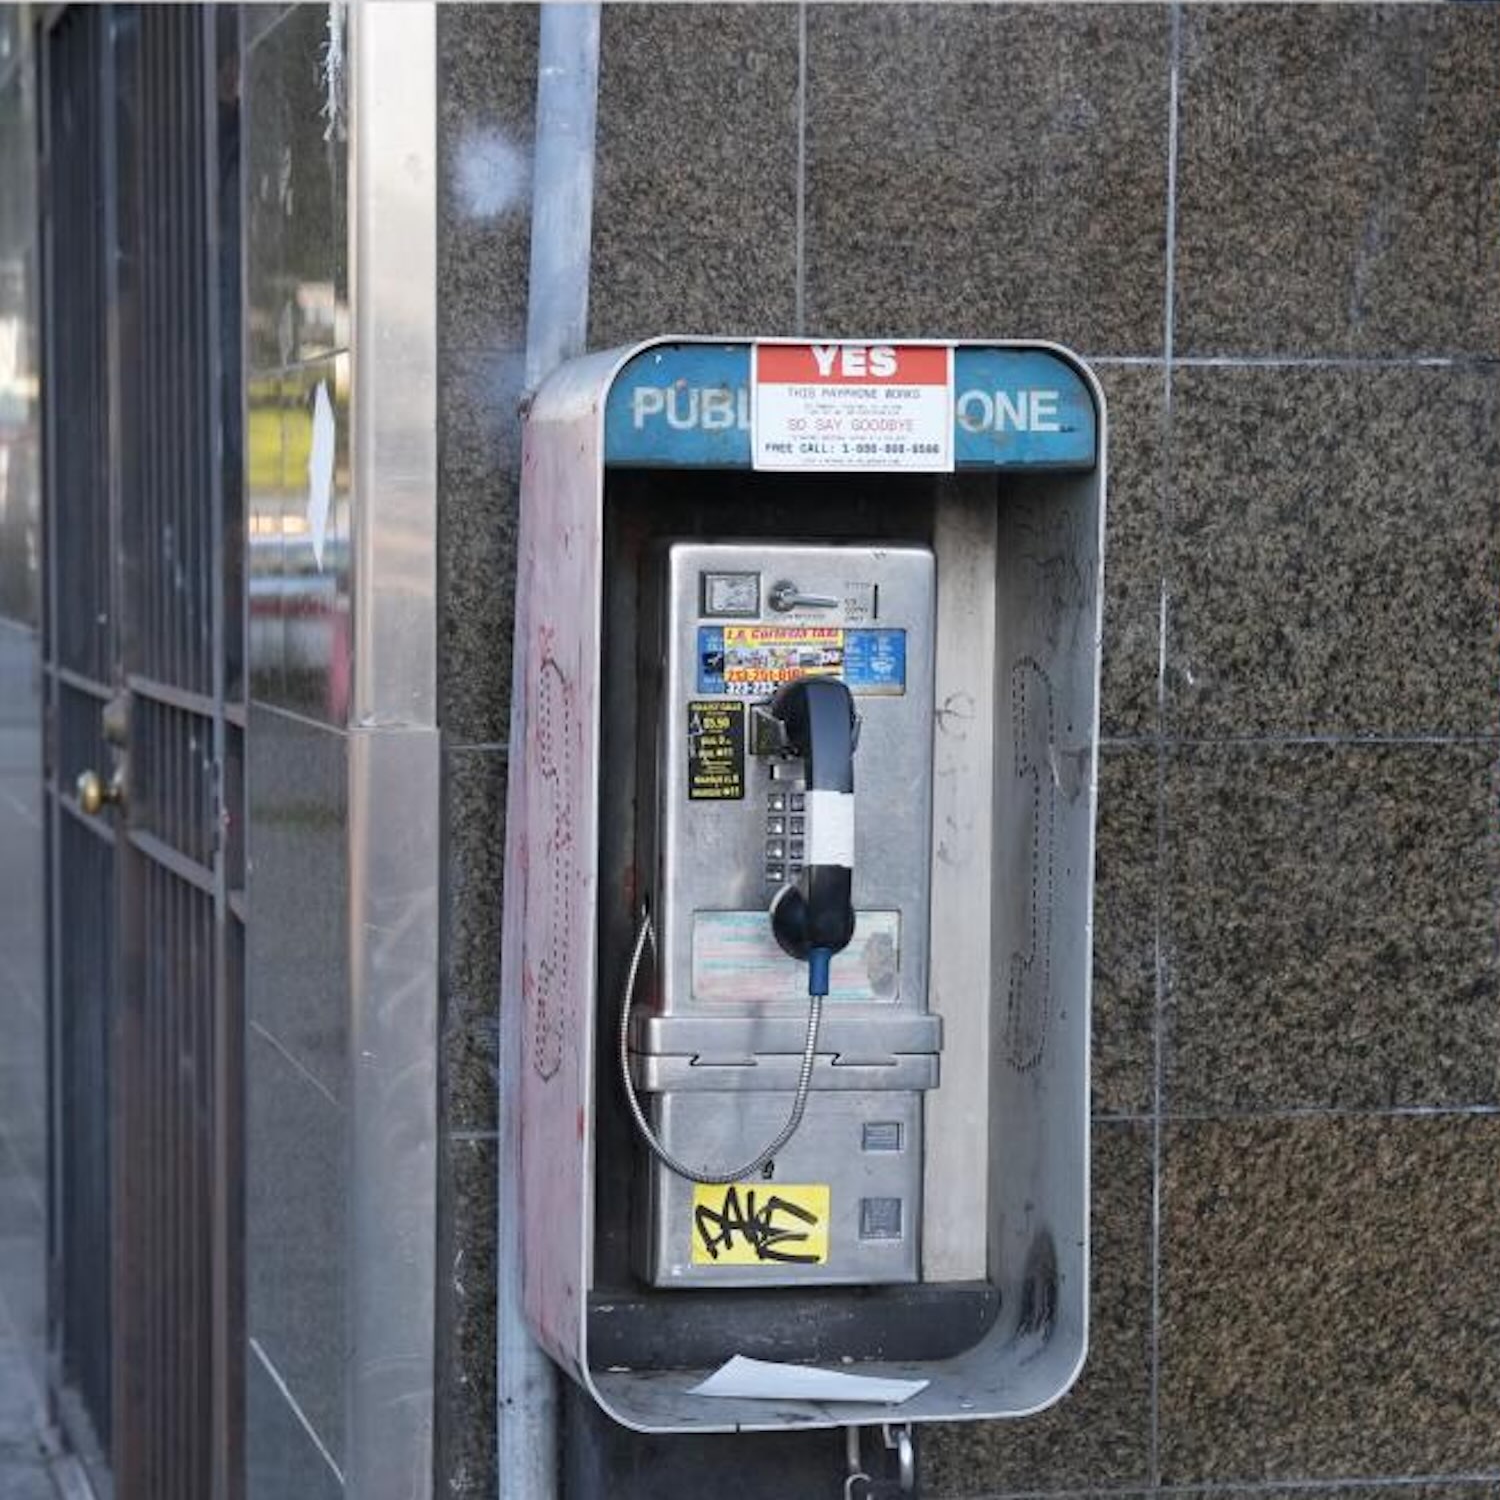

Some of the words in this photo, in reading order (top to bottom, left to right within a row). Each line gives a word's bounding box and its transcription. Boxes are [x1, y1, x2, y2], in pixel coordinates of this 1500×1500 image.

[811, 345, 898, 377] YES
[633, 387, 750, 430] PUBL
[957, 389, 1060, 432] ONE
[815, 419, 843, 431] SAY
[851, 419, 914, 432] GOODBYE
[765, 443, 793, 454] FREE
[801, 443, 836, 454] CALL:
